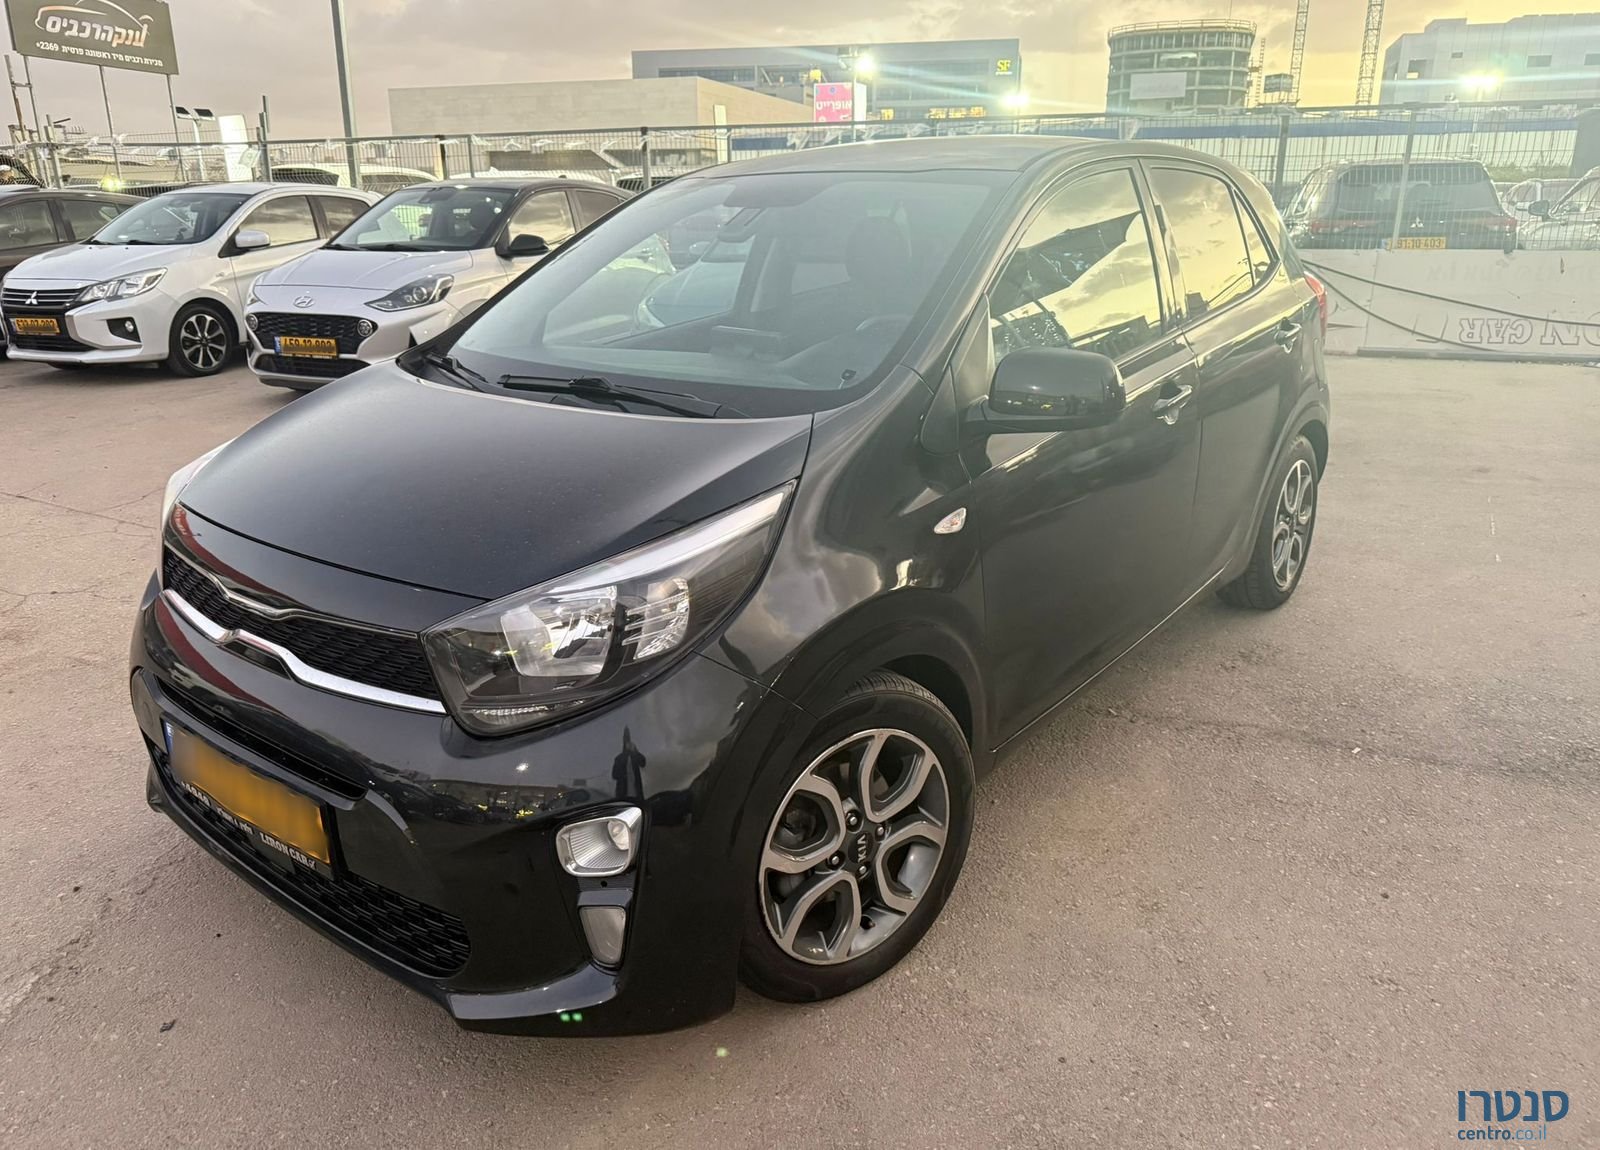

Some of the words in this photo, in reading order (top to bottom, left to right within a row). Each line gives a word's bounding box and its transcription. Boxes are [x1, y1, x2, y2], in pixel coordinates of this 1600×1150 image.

[1458, 318, 1533, 344] CAR
[259, 832, 290, 856] LIRON
[856, 833, 868, 864] KIA
